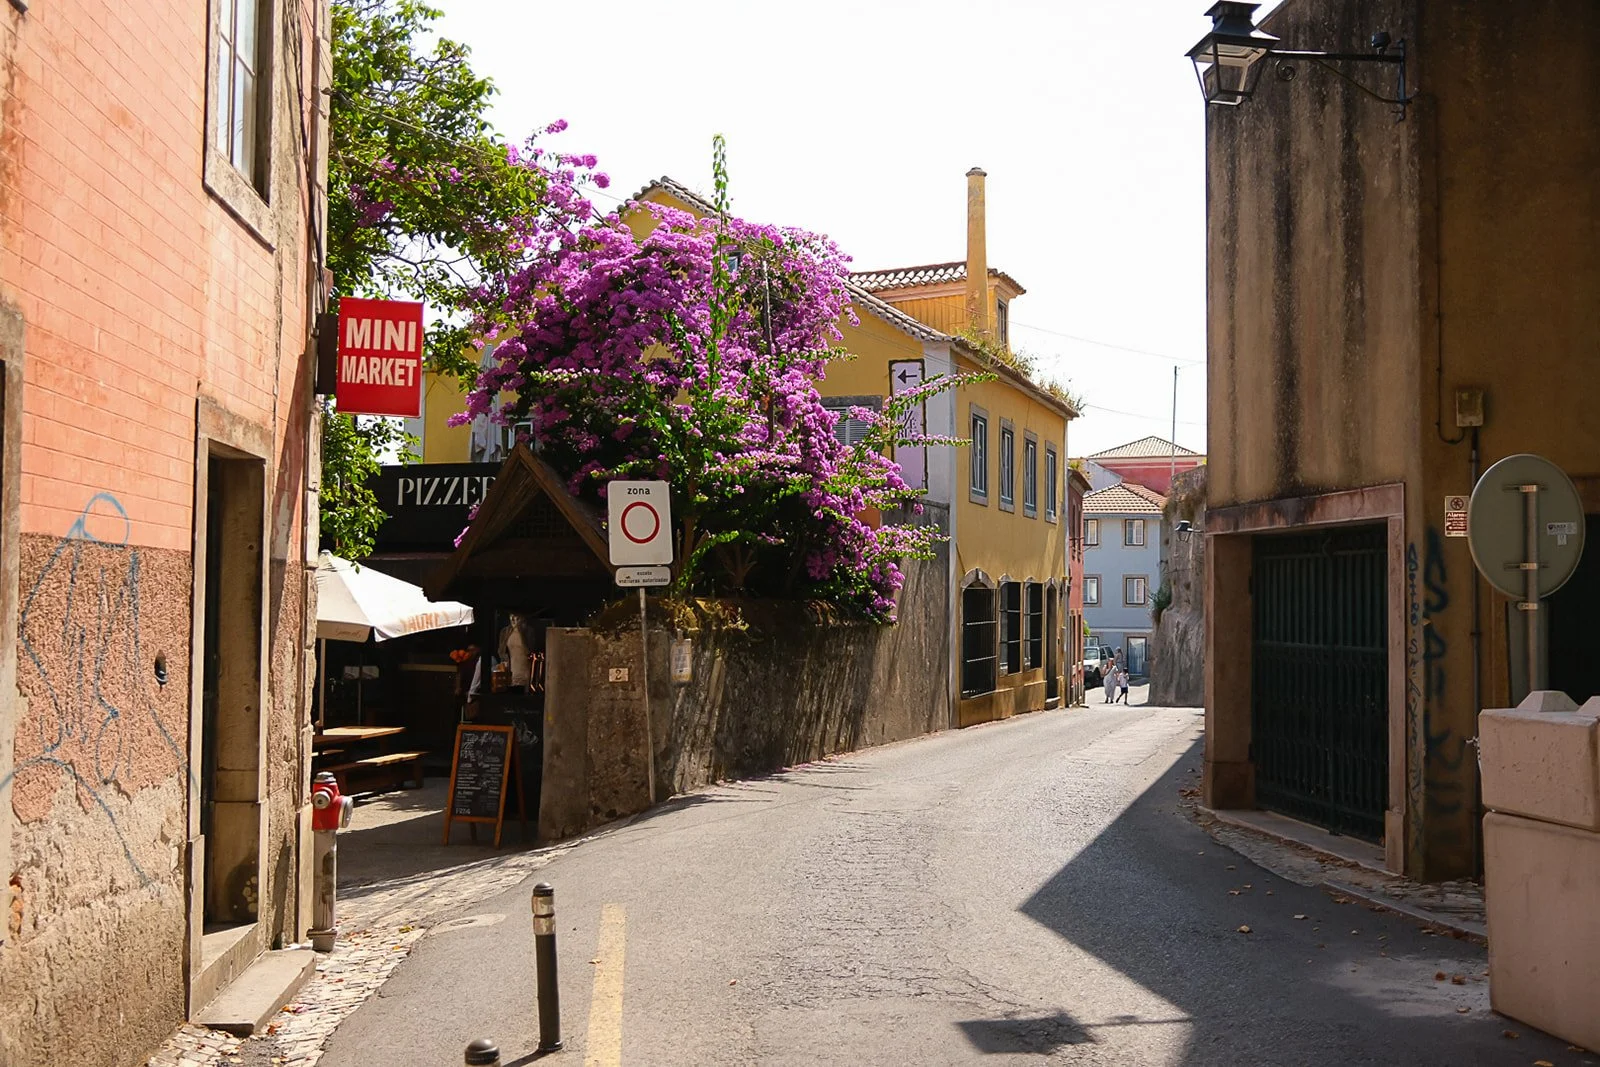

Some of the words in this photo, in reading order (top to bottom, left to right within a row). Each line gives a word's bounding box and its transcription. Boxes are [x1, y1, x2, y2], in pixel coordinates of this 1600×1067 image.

[345, 317, 417, 352] MINI
[341, 355, 418, 387] MARKET
[626, 487, 651, 495] zona
[615, 669, 622, 680] 2
